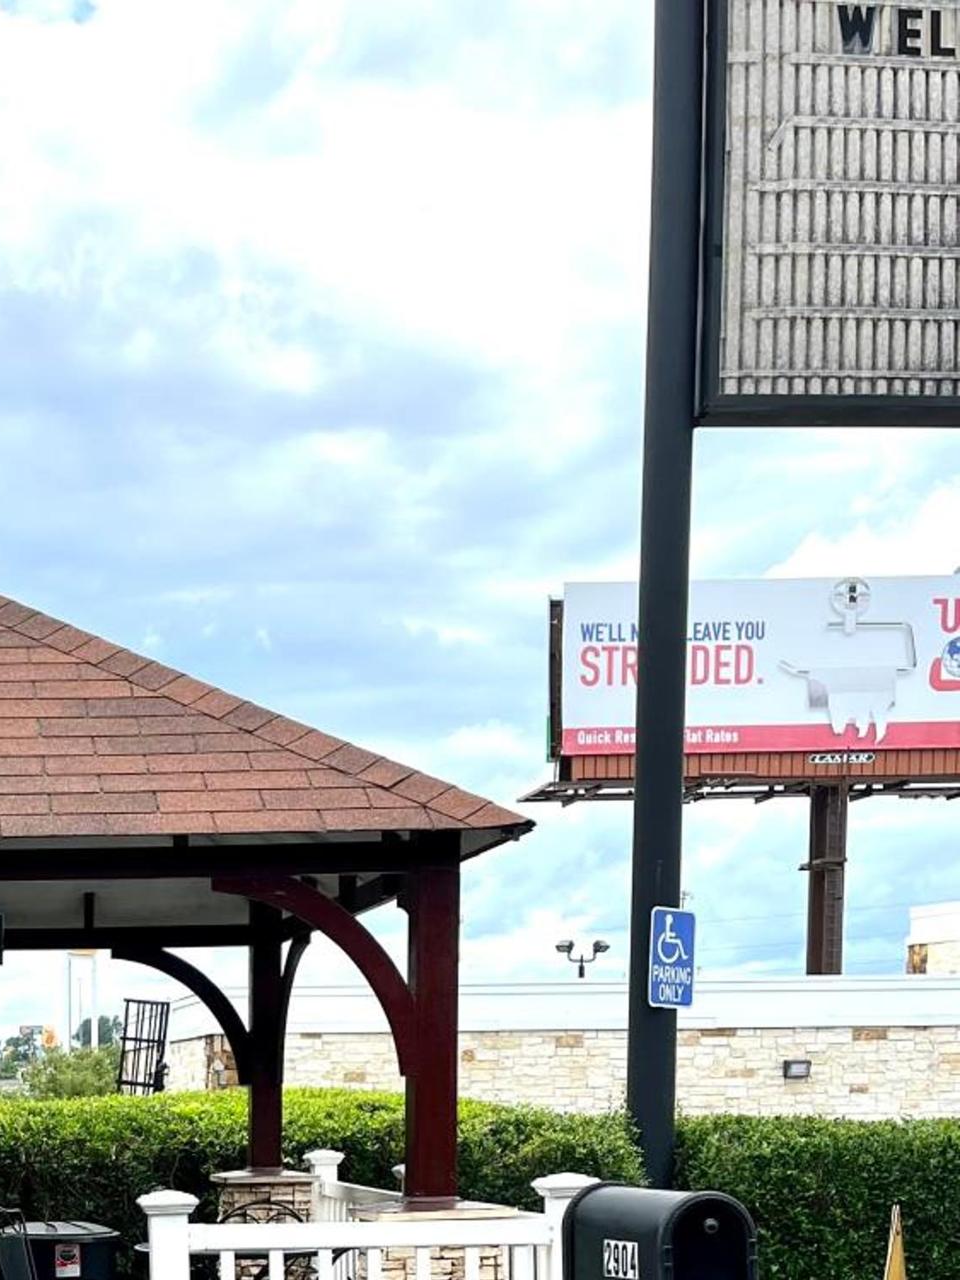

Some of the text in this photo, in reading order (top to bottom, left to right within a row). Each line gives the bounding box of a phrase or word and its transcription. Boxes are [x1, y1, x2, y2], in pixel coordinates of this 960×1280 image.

[837, 5, 956, 56] WEL
[581, 623, 626, 642] WE'LL
[686, 621, 733, 641] EAVE
[736, 621, 765, 640] YOU
[580, 644, 764, 687] STRDED.
[577, 730, 613, 745] Quick
[705, 729, 738, 744] Rates
[652, 964, 691, 985] PARKING
[659, 983, 684, 1002] ONLY
[604, 1242, 636, 1278] 2904
